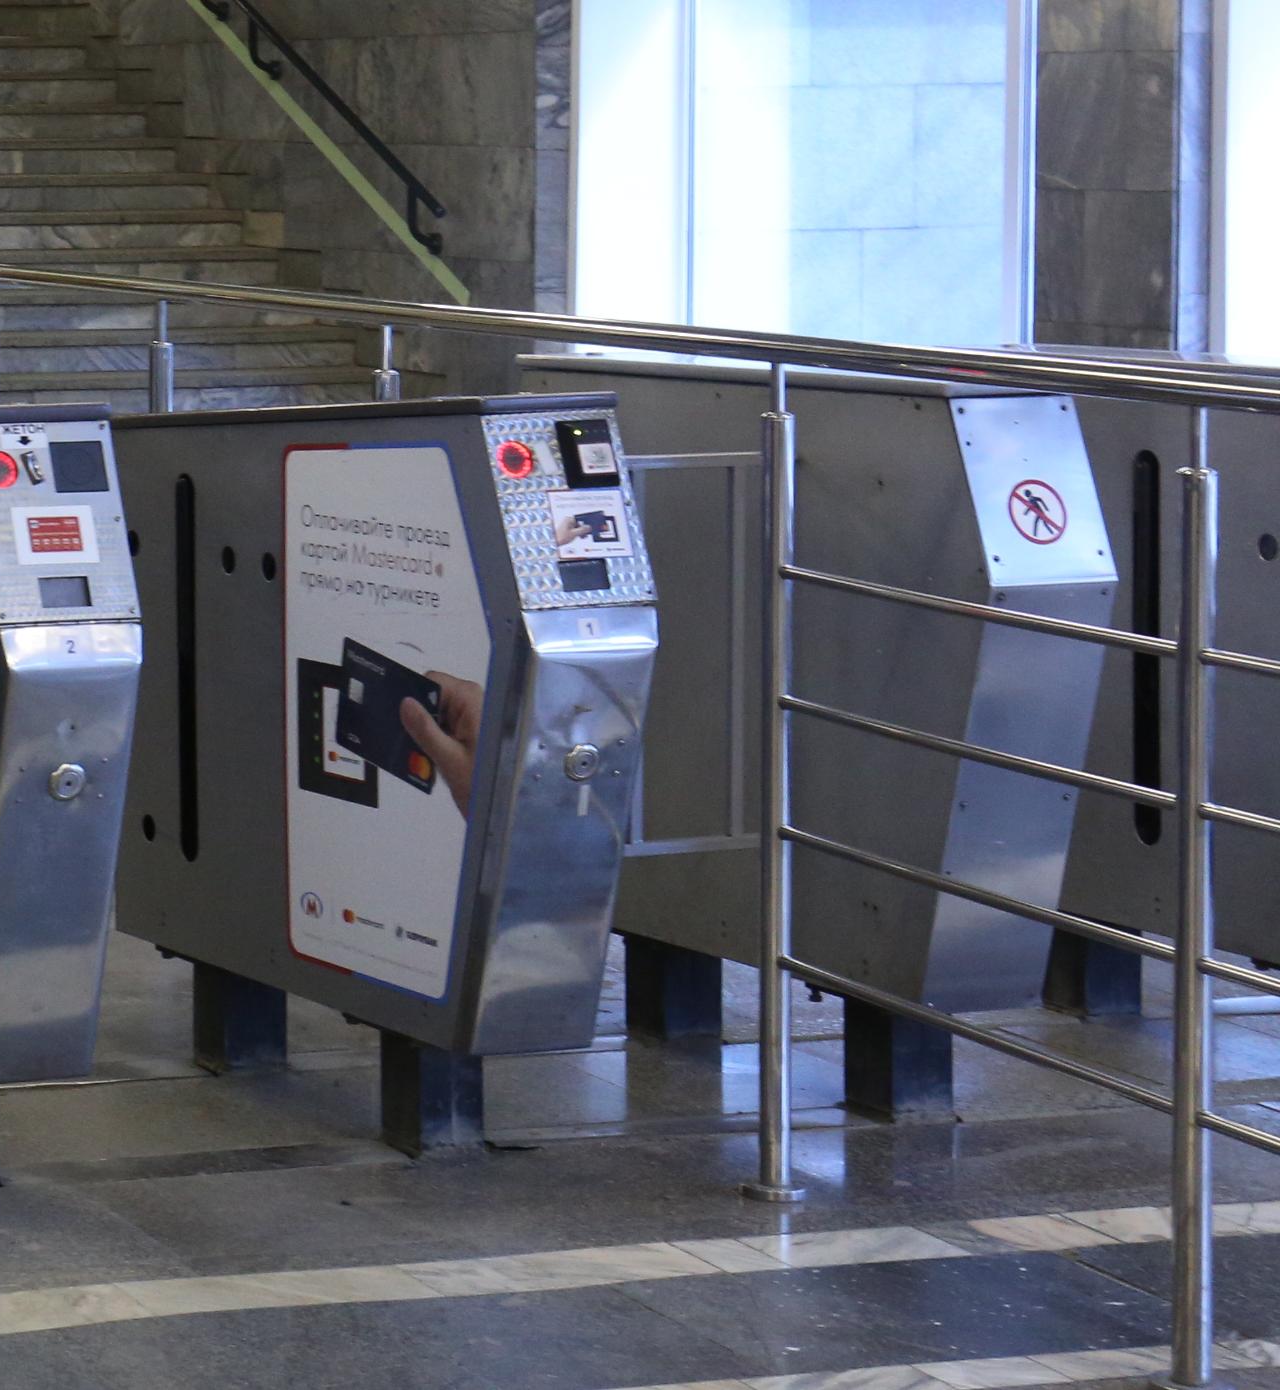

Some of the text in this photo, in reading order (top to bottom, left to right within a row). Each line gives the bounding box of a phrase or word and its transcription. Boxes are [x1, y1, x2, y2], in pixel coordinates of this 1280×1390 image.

[1, 423, 46, 435] ЖЕТОН
[301, 504, 451, 549] Оплачивайте проезд
[301, 542, 433, 577] картой Mastercard
[301, 571, 442, 609] прямо на турникете
[66, 639, 76, 654] 2
